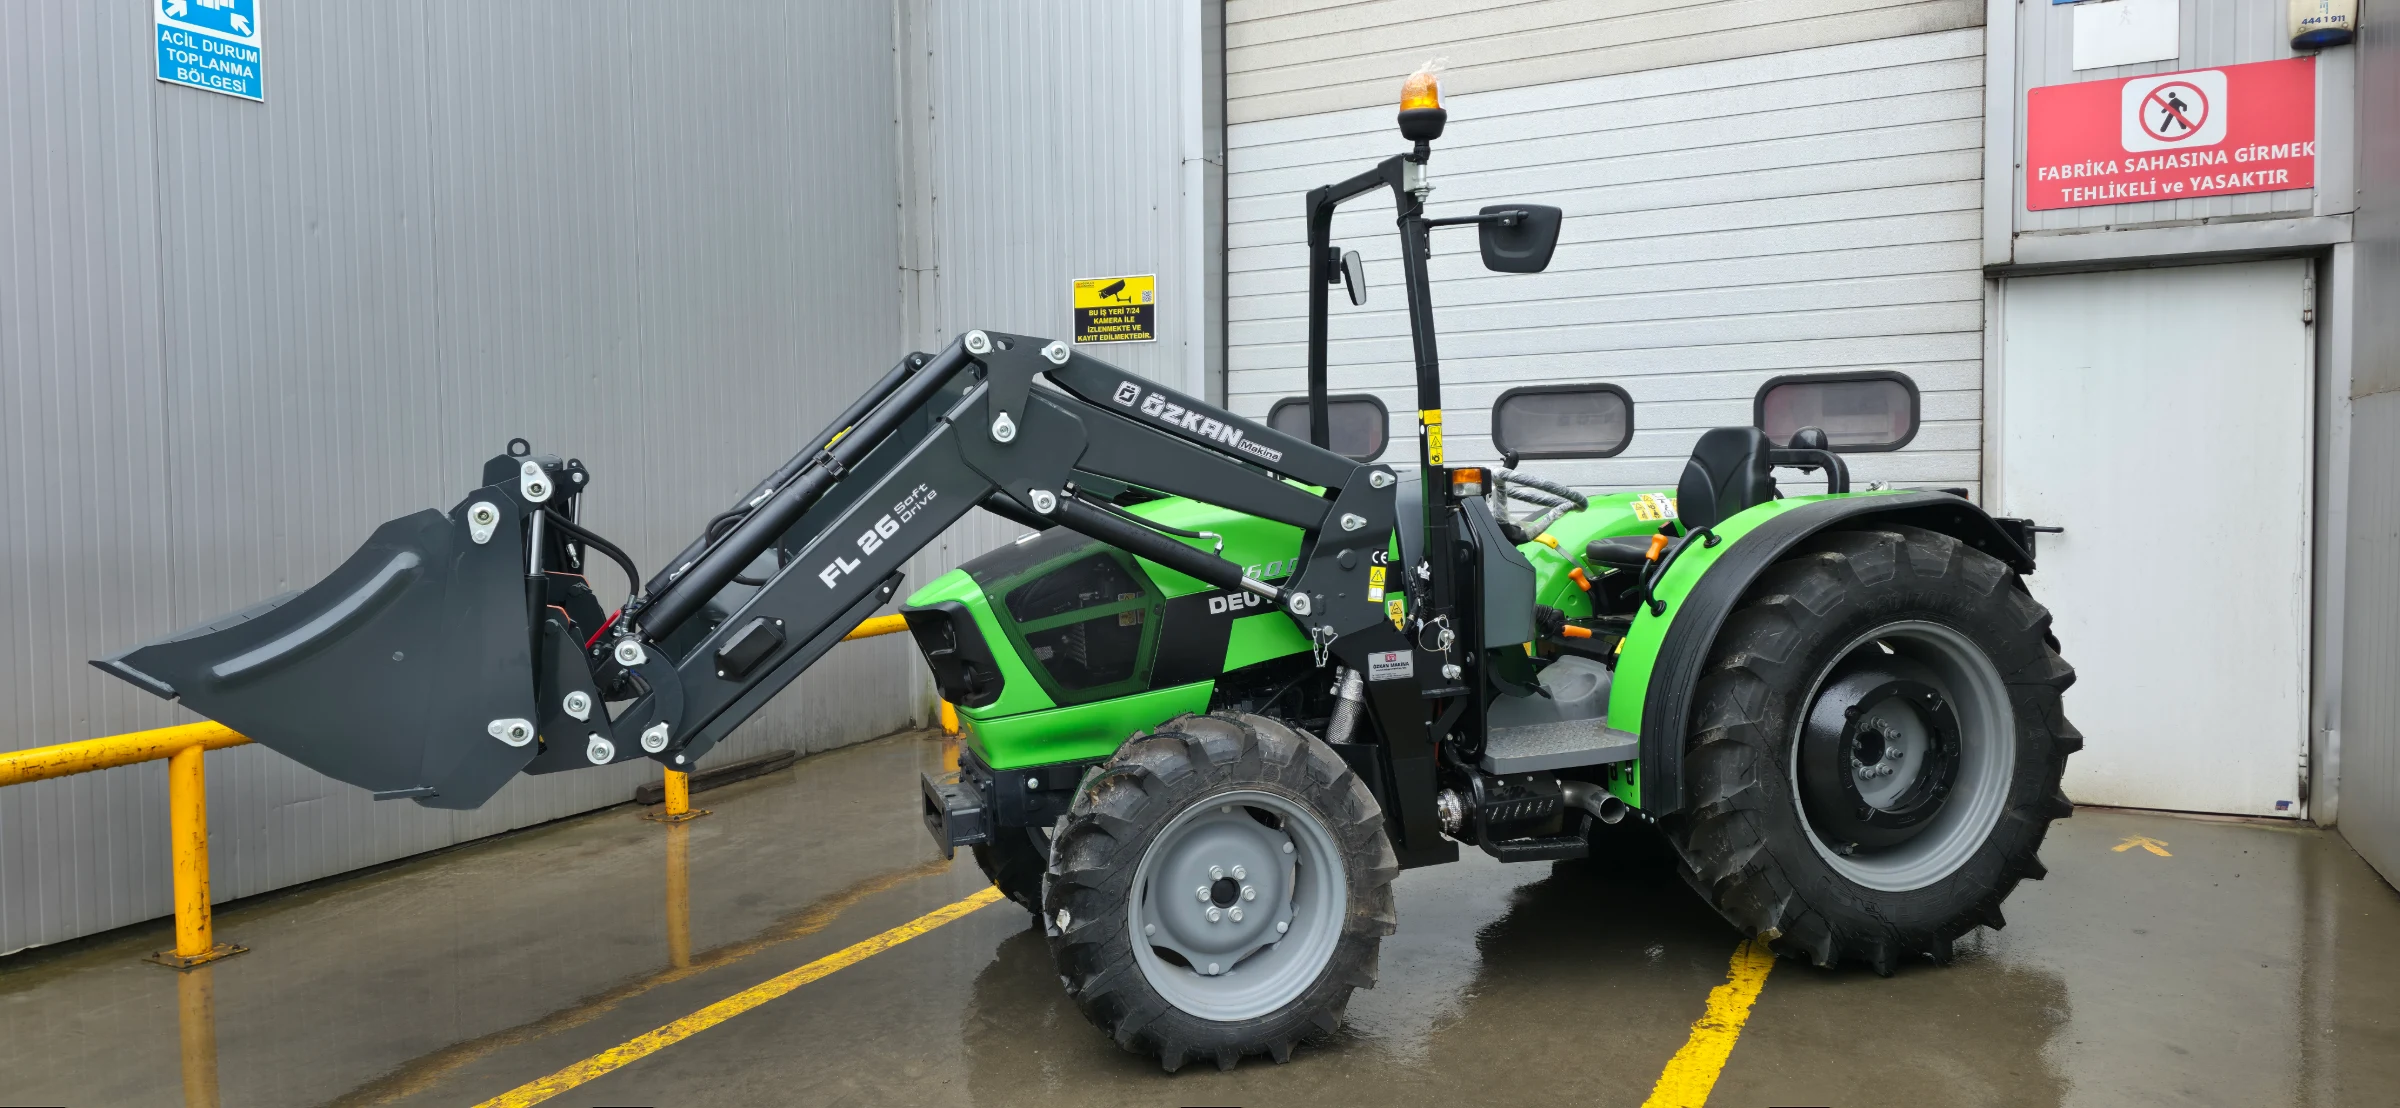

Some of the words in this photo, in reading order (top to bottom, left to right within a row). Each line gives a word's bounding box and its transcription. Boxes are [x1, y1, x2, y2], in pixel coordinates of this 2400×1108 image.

[2302, 16, 2321, 25] 444
[161, 29, 198, 49] ACİL
[202, 39, 258, 63] DURUM
[166, 47, 254, 79] TOPLANMA
[177, 67, 246, 93] BÖLGESİ
[2038, 159, 2118, 181] FABRİKA
[2124, 150, 2228, 173] SAHASINA
[2234, 141, 2315, 162] GİRMEK
[2061, 177, 2156, 202] TEHLİKELİ
[2162, 182, 2183, 193] ve
[2190, 168, 2288, 191] YASAKTIR
[1100, 308, 1106, 316] İŞ
[1108, 307, 1124, 315] YERİ
[1077, 334, 1098, 342] KAYIT
[1100, 332, 1152, 340] EDİLMEKTEDİR.
[1088, 325, 1130, 333] İZLENMEKTE
[1140, 391, 1244, 448] ÖZKAN
[1240, 440, 1281, 461] Makina
[894, 482, 928, 514] Soft
[900, 489, 938, 524] Drive
[818, 556, 861, 589] FL
[856, 514, 900, 556] 26
[1372, 551, 1388, 564] CE
[1208, 592, 1273, 614] DEU
